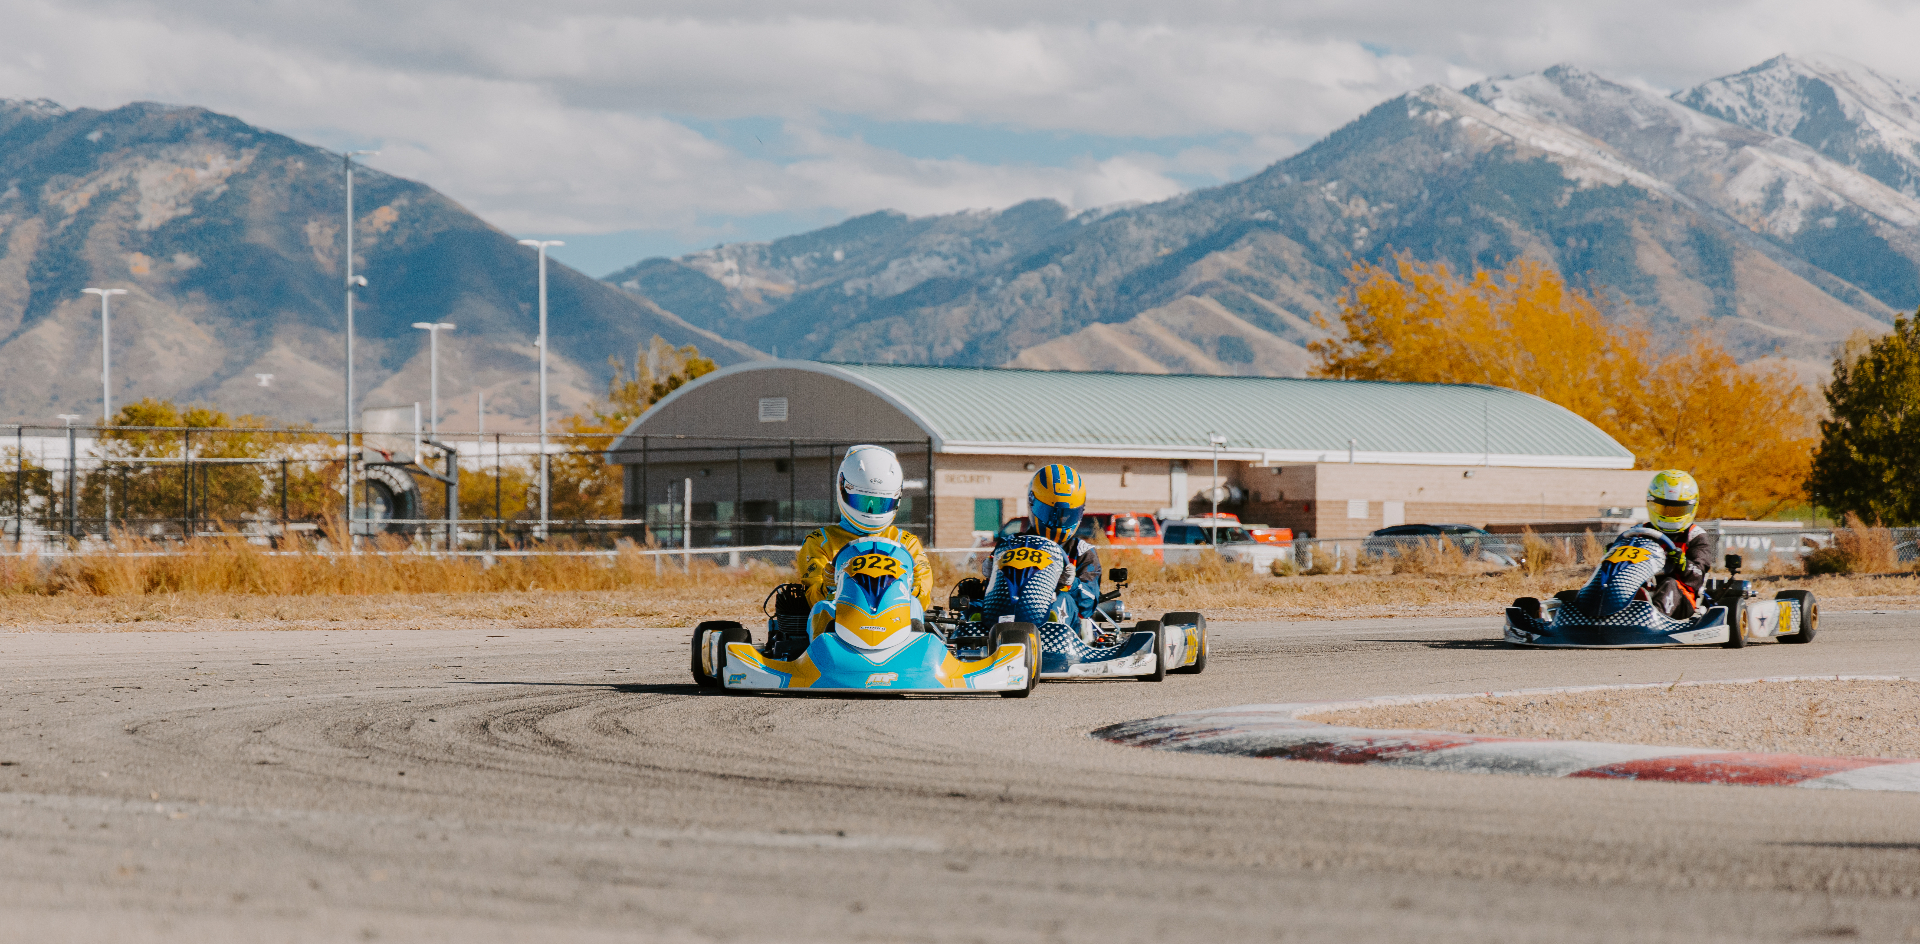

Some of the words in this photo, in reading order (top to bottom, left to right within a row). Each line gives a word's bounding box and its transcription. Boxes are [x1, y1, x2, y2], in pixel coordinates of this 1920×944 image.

[944, 473, 992, 484] SECURITY
[1002, 549, 1042, 564] 998
[852, 555, 897, 574] 922
